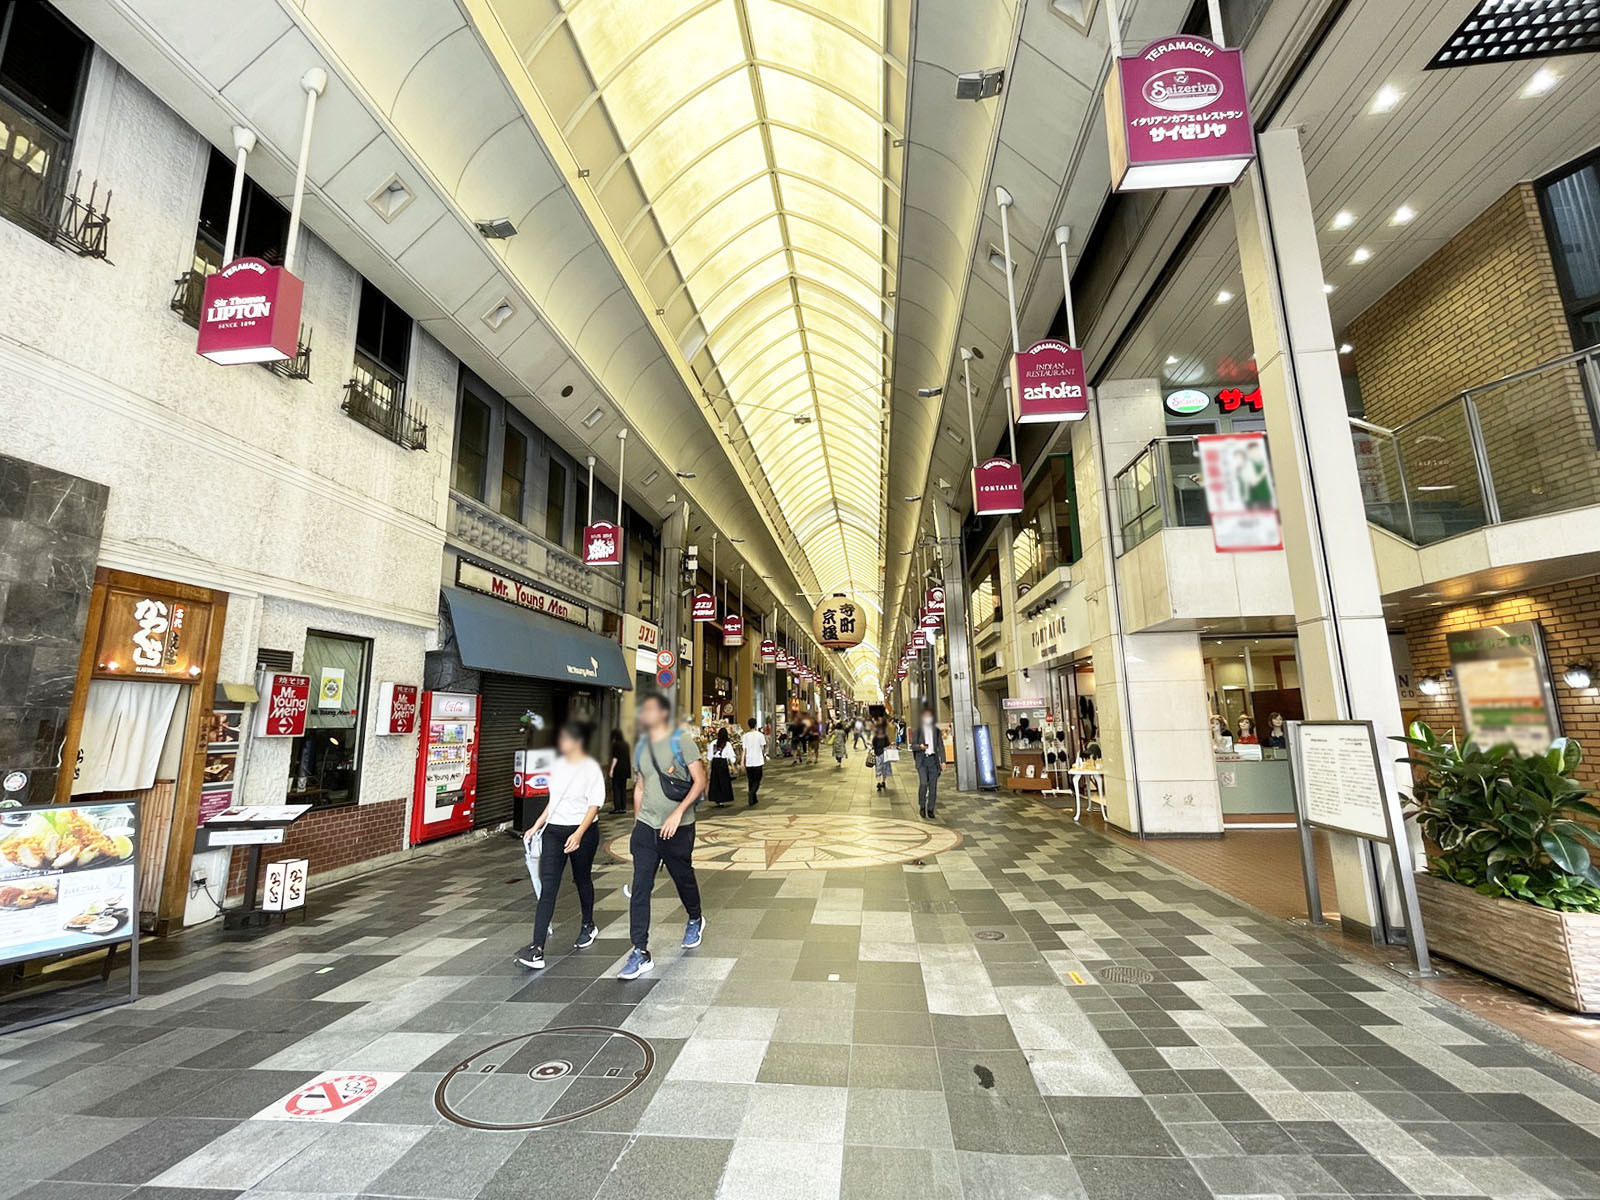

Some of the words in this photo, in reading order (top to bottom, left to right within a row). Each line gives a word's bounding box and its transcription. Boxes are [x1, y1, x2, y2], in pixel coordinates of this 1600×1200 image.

[1145, 41, 1214, 63] TERAMACHI
[1150, 80, 1217, 101] Saizeriya
[1149, 122, 1228, 143] サイゼリヤ
[222, 262, 267, 278] TERAMACHI
[214, 298, 228, 308] Sir
[229, 295, 266, 306] Thomas
[206, 302, 272, 323] LIPTON
[1029, 343, 1068, 355] TERAMACHI
[1026, 368, 1076, 378] RESTAURANT
[1035, 362, 1065, 371] INDIAN
[1023, 380, 1083, 400] ashoka
[980, 484, 1018, 492] FONTAINE
[491, 577, 509, 597] Mr.
[514, 583, 545, 608] Young
[547, 600, 568, 617] Men
[822, 609, 839, 640] 京極
[839, 603, 856, 633] 寺町
[132, 598, 169, 667] かつくら
[638, 625, 656, 645] クスリ
[1031, 616, 1066, 648] FONTAINE
[280, 686, 296, 698] Mr.
[269, 707, 298, 719] Men
[273, 695, 307, 711] Young
[393, 701, 416, 714] Young
[392, 710, 410, 720] Men
[270, 872, 281, 903] かつくら
[290, 868, 303, 900] かつくら
